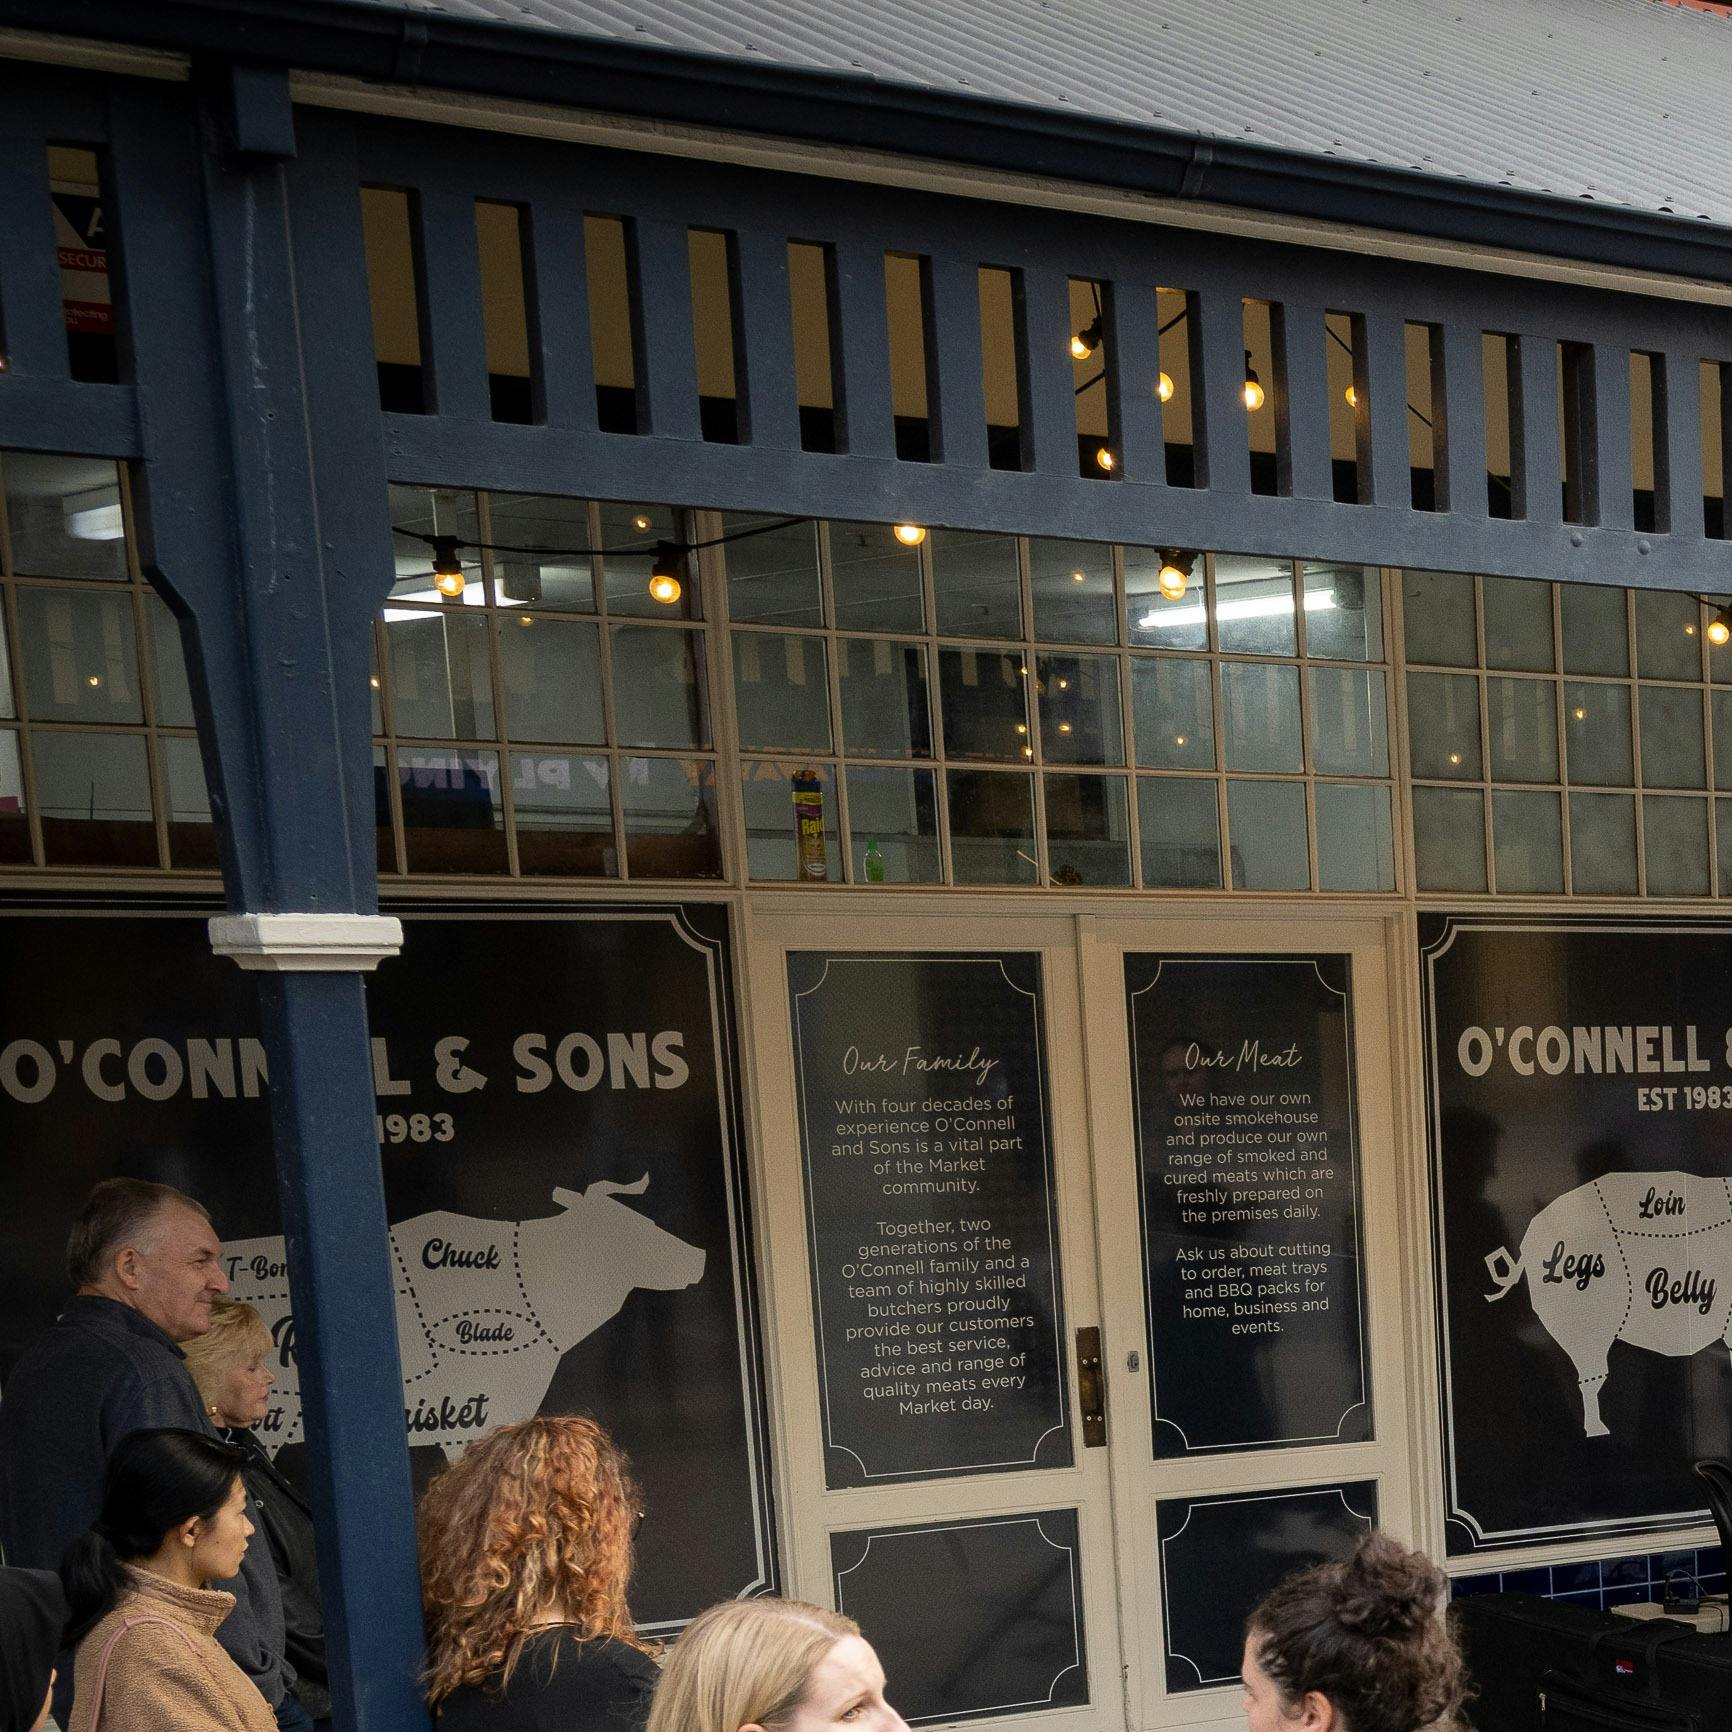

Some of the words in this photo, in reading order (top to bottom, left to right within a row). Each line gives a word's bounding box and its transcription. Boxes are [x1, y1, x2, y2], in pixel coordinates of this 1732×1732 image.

[434, 1036, 488, 1094] &
[512, 1030, 690, 1094] SONS
[843, 1046, 898, 1075] Our
[903, 1046, 999, 1086] Family
[1185, 1042, 1235, 1070] Our
[1236, 1039, 1303, 1073] Meat
[1457, 1025, 1710, 1077] O'CONNELL
[835, 1099, 876, 1114] With
[882, 1098, 916, 1113] four
[922, 1097, 992, 1112] decades
[997, 1096, 1014, 1110] of
[1637, 1087, 1678, 1112] EST
[836, 1120, 929, 1137] experience
[935, 1115, 1016, 1132] O'Connell
[832, 1141, 864, 1156] and
[869, 1140, 911, 1155] Sons
[916, 1138, 928, 1153] is
[934, 1141, 944, 1152] a
[949, 1136, 983, 1151] vital
[989, 1136, 1023, 1153] part
[873, 1160, 890, 1175] of
[896, 1159, 924, 1174] the
[929, 1157, 986, 1172] Market
[882, 1178, 980, 1195] community.
[1638, 1186, 1686, 1219] Loin
[421, 1238, 501, 1270] Chuck
[1542, 1240, 1606, 1292] Legs
[1645, 1267, 1718, 1315] Belly
[455, 1319, 515, 1345] Blade
